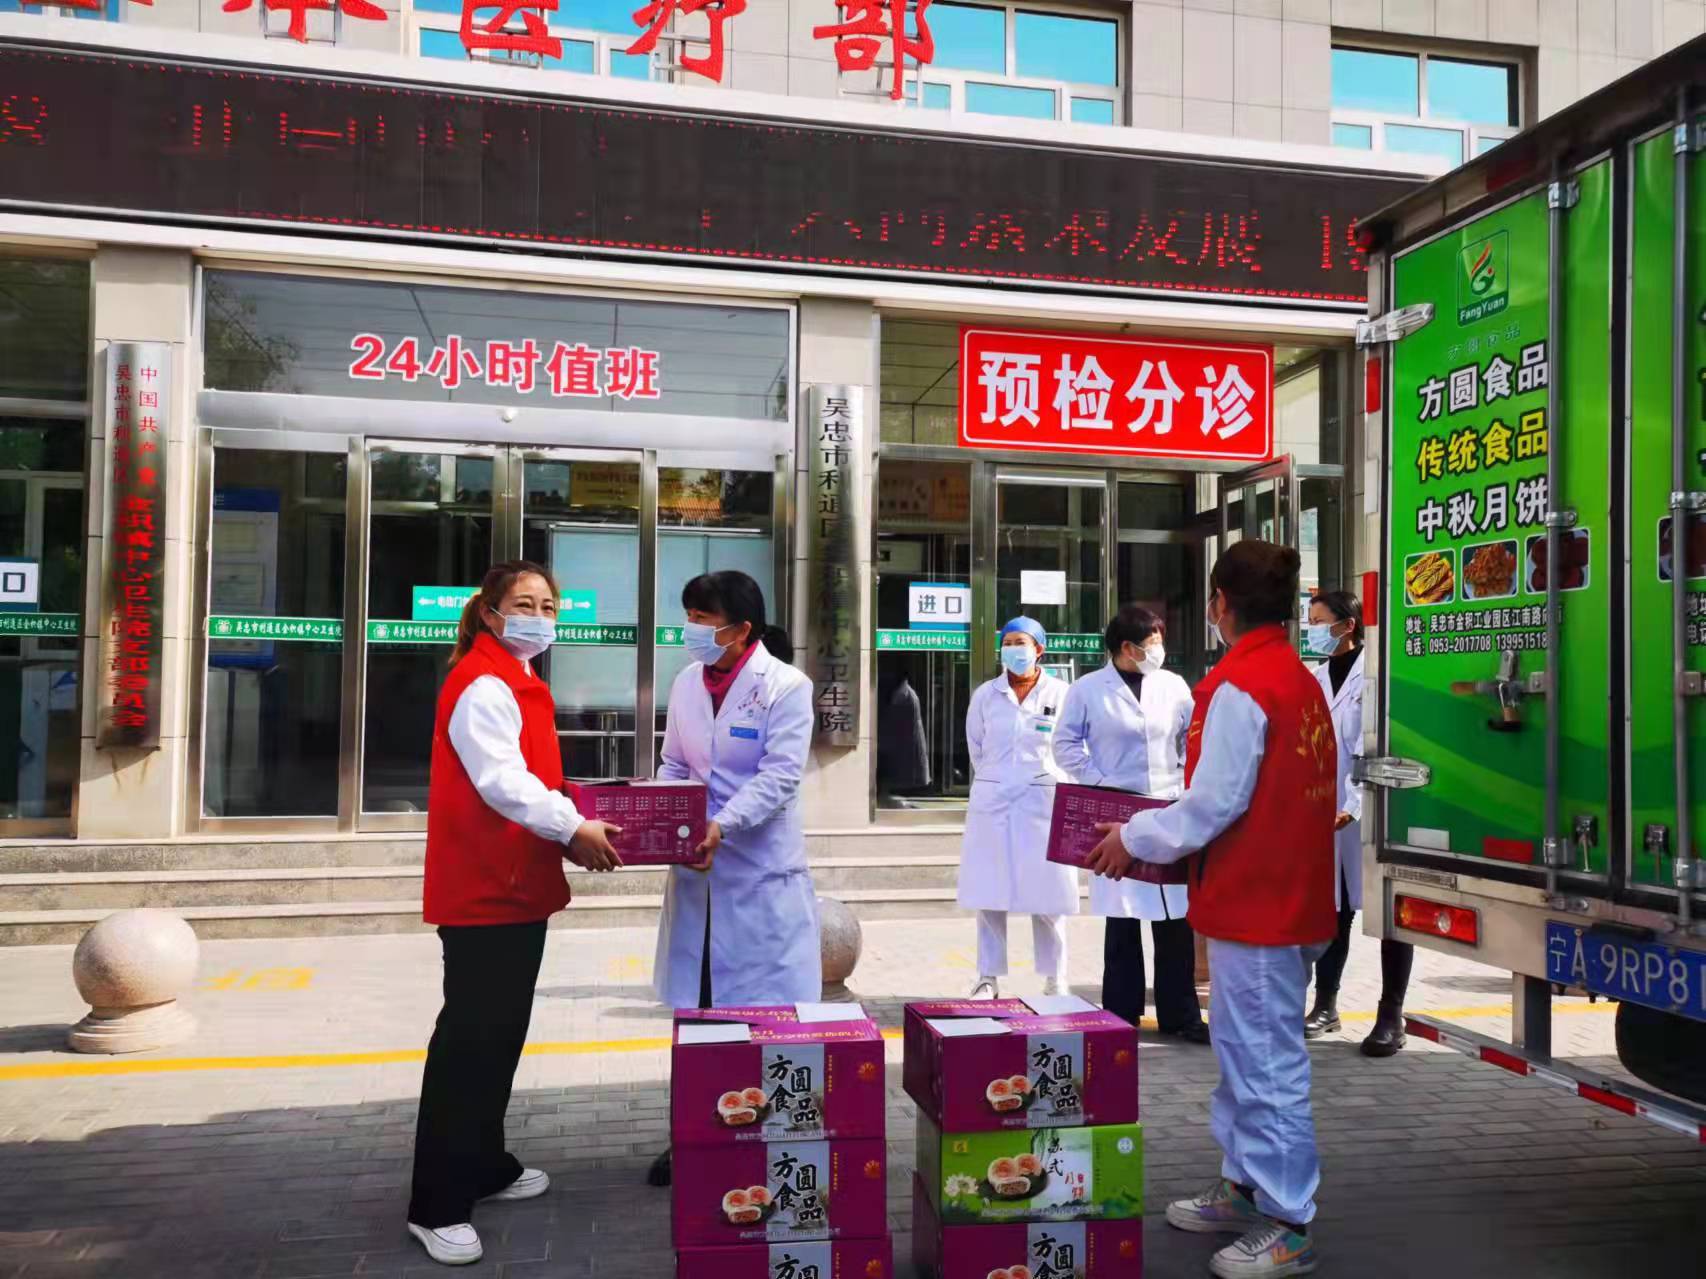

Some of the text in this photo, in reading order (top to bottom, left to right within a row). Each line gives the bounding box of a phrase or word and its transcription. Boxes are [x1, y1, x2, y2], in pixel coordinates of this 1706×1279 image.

[1460, 298, 1505, 320] FangYuan
[349, 333, 662, 401] 24小时值班
[978, 350, 1256, 440] 预检分诊
[1419, 343, 1548, 421] 方圆食品
[1418, 410, 1548, 481] 传统食品
[1417, 477, 1548, 541] 中秋月饼
[917, 594, 962, 614] 进口
